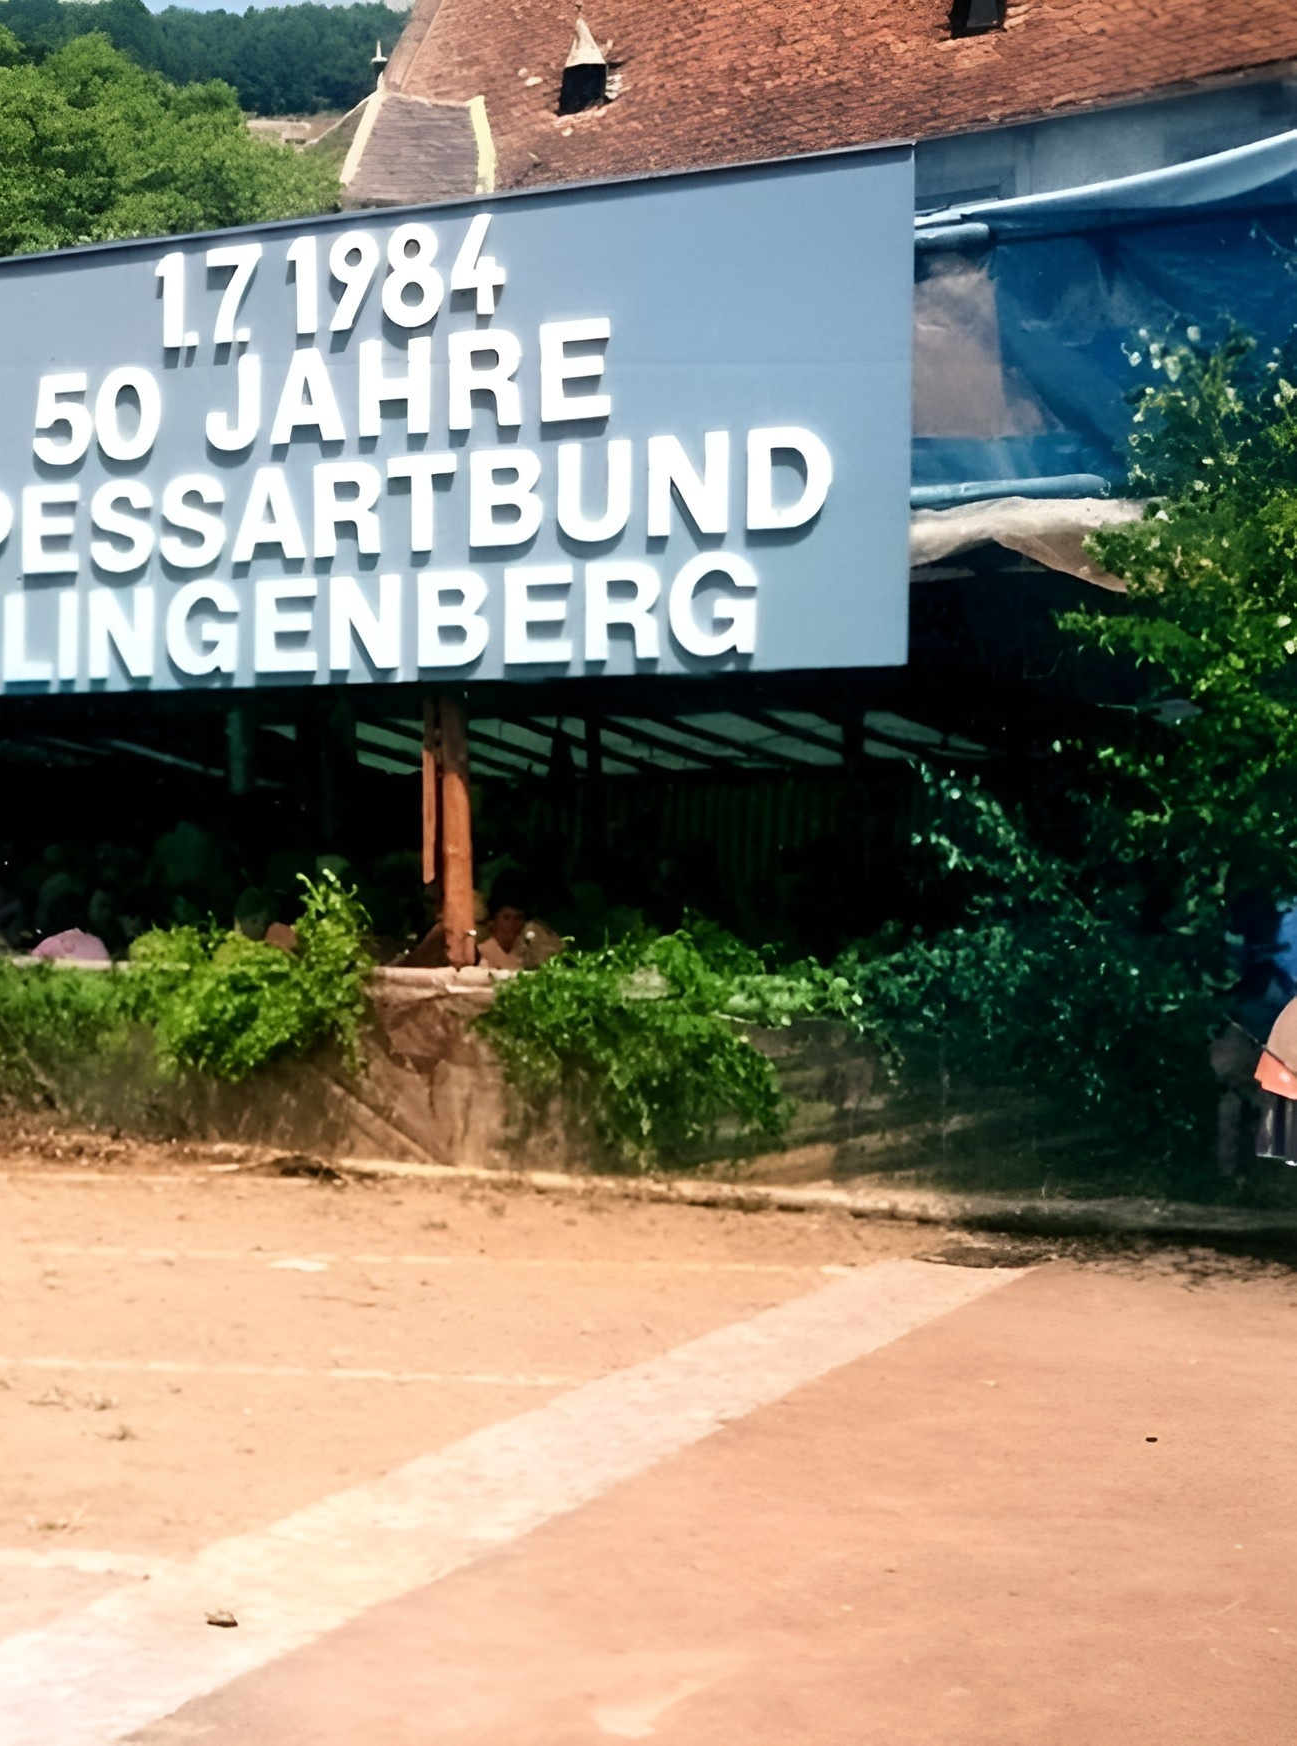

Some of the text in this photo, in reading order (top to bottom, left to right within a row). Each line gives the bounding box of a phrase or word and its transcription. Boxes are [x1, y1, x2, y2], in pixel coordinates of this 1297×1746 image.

[286, 213, 507, 335] 1984
[32, 317, 613, 466] 50 JAHRE
